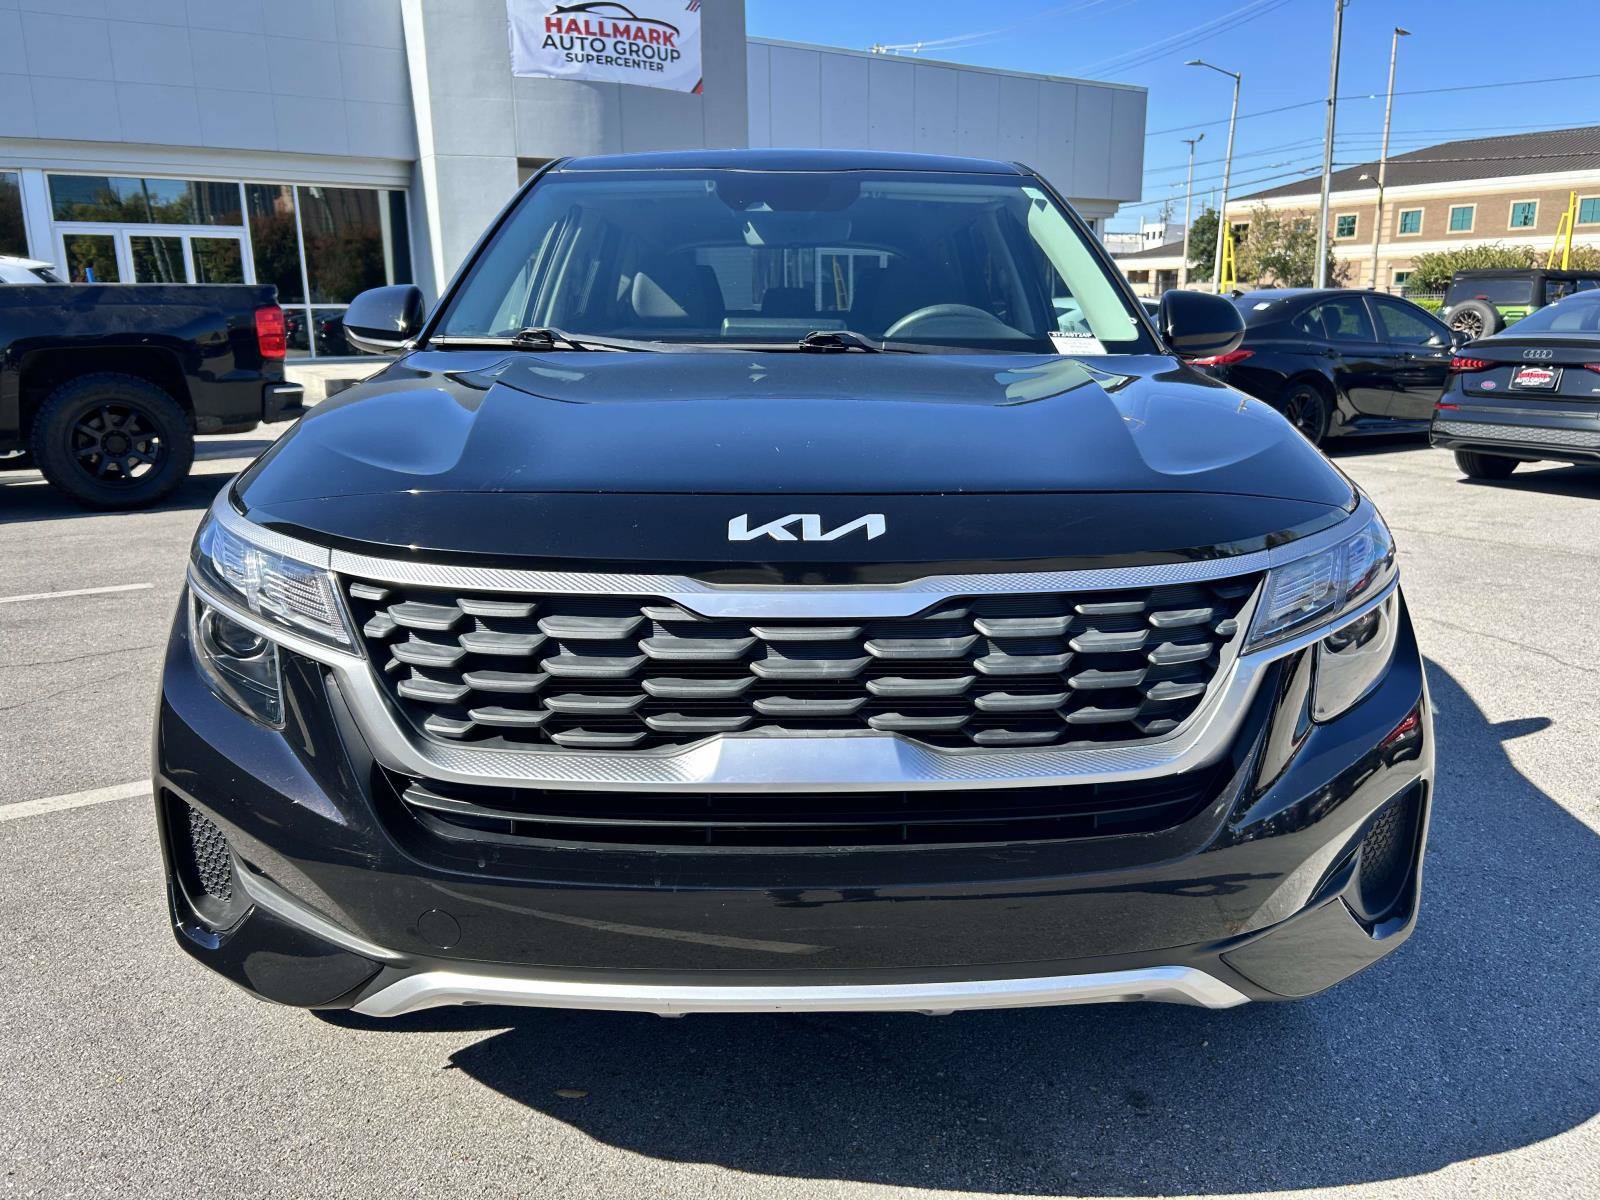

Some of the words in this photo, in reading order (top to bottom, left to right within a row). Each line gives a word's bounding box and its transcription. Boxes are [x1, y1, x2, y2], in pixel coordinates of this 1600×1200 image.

[544, 16, 676, 48] HALLMARK
[542, 34, 606, 53] AUTO
[613, 40, 681, 63] GROUP
[565, 52, 665, 72] SUPERCENTER
